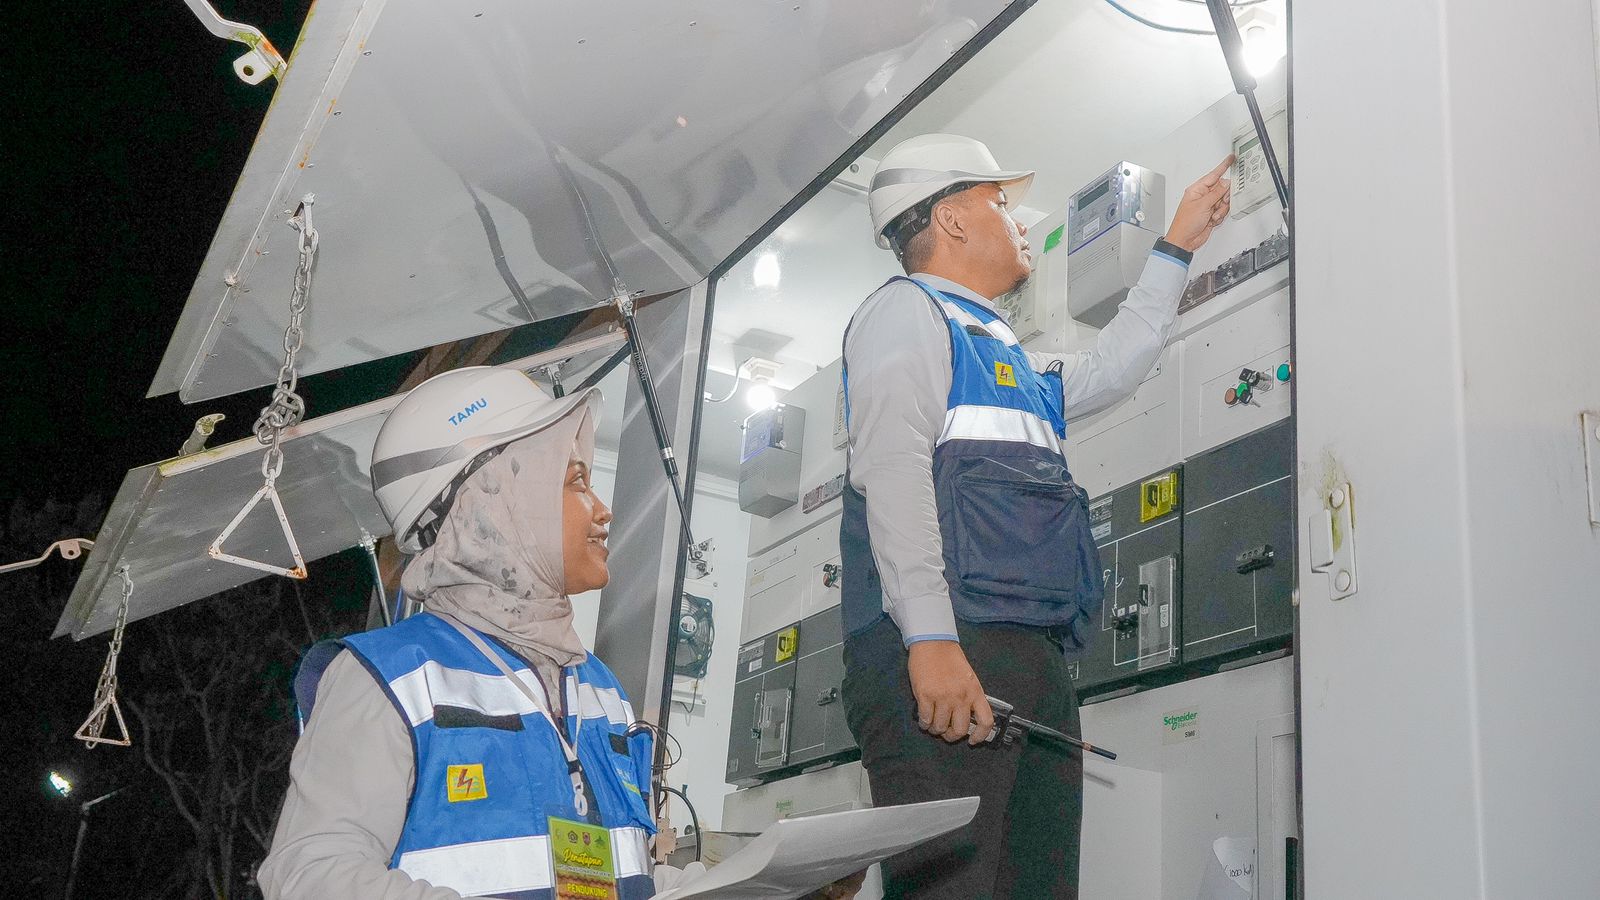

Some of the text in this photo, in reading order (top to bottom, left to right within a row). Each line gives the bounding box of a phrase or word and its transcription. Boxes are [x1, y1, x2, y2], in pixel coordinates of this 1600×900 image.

[448, 398, 487, 426] TAMU
[1163, 711, 1198, 726] Schneider
[567, 883, 609, 899] PENDUKUNG
